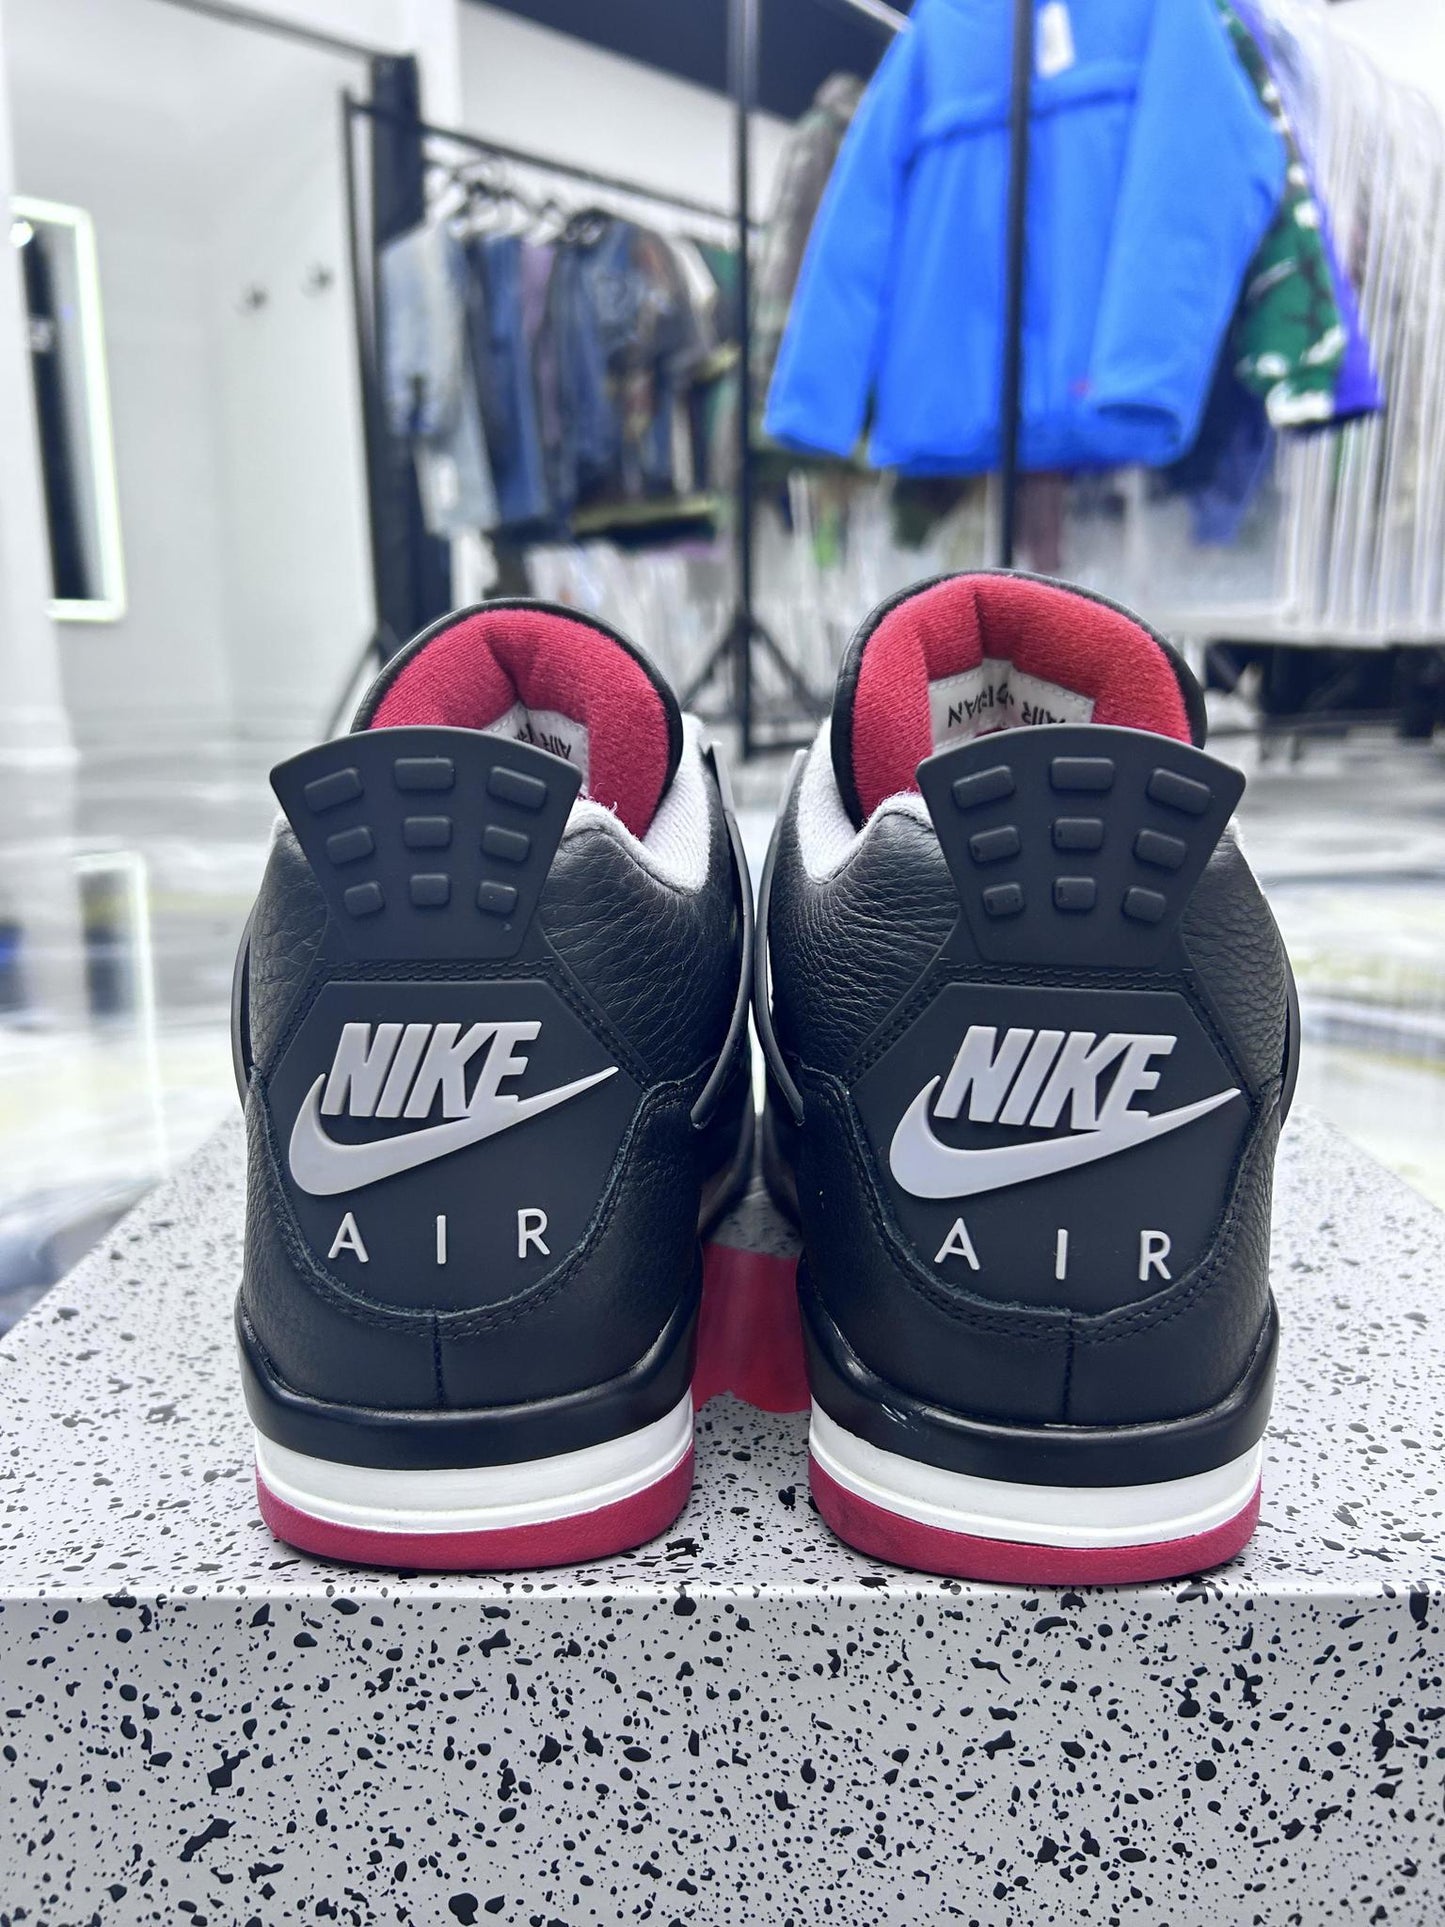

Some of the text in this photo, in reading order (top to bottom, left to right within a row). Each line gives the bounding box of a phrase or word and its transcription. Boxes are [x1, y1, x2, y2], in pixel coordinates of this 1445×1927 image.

[320, 1021, 543, 1119] NIKE
[932, 1025, 1178, 1131] NIKE
[327, 1207, 551, 1265] AIR
[933, 1217, 1172, 1281] AIR
